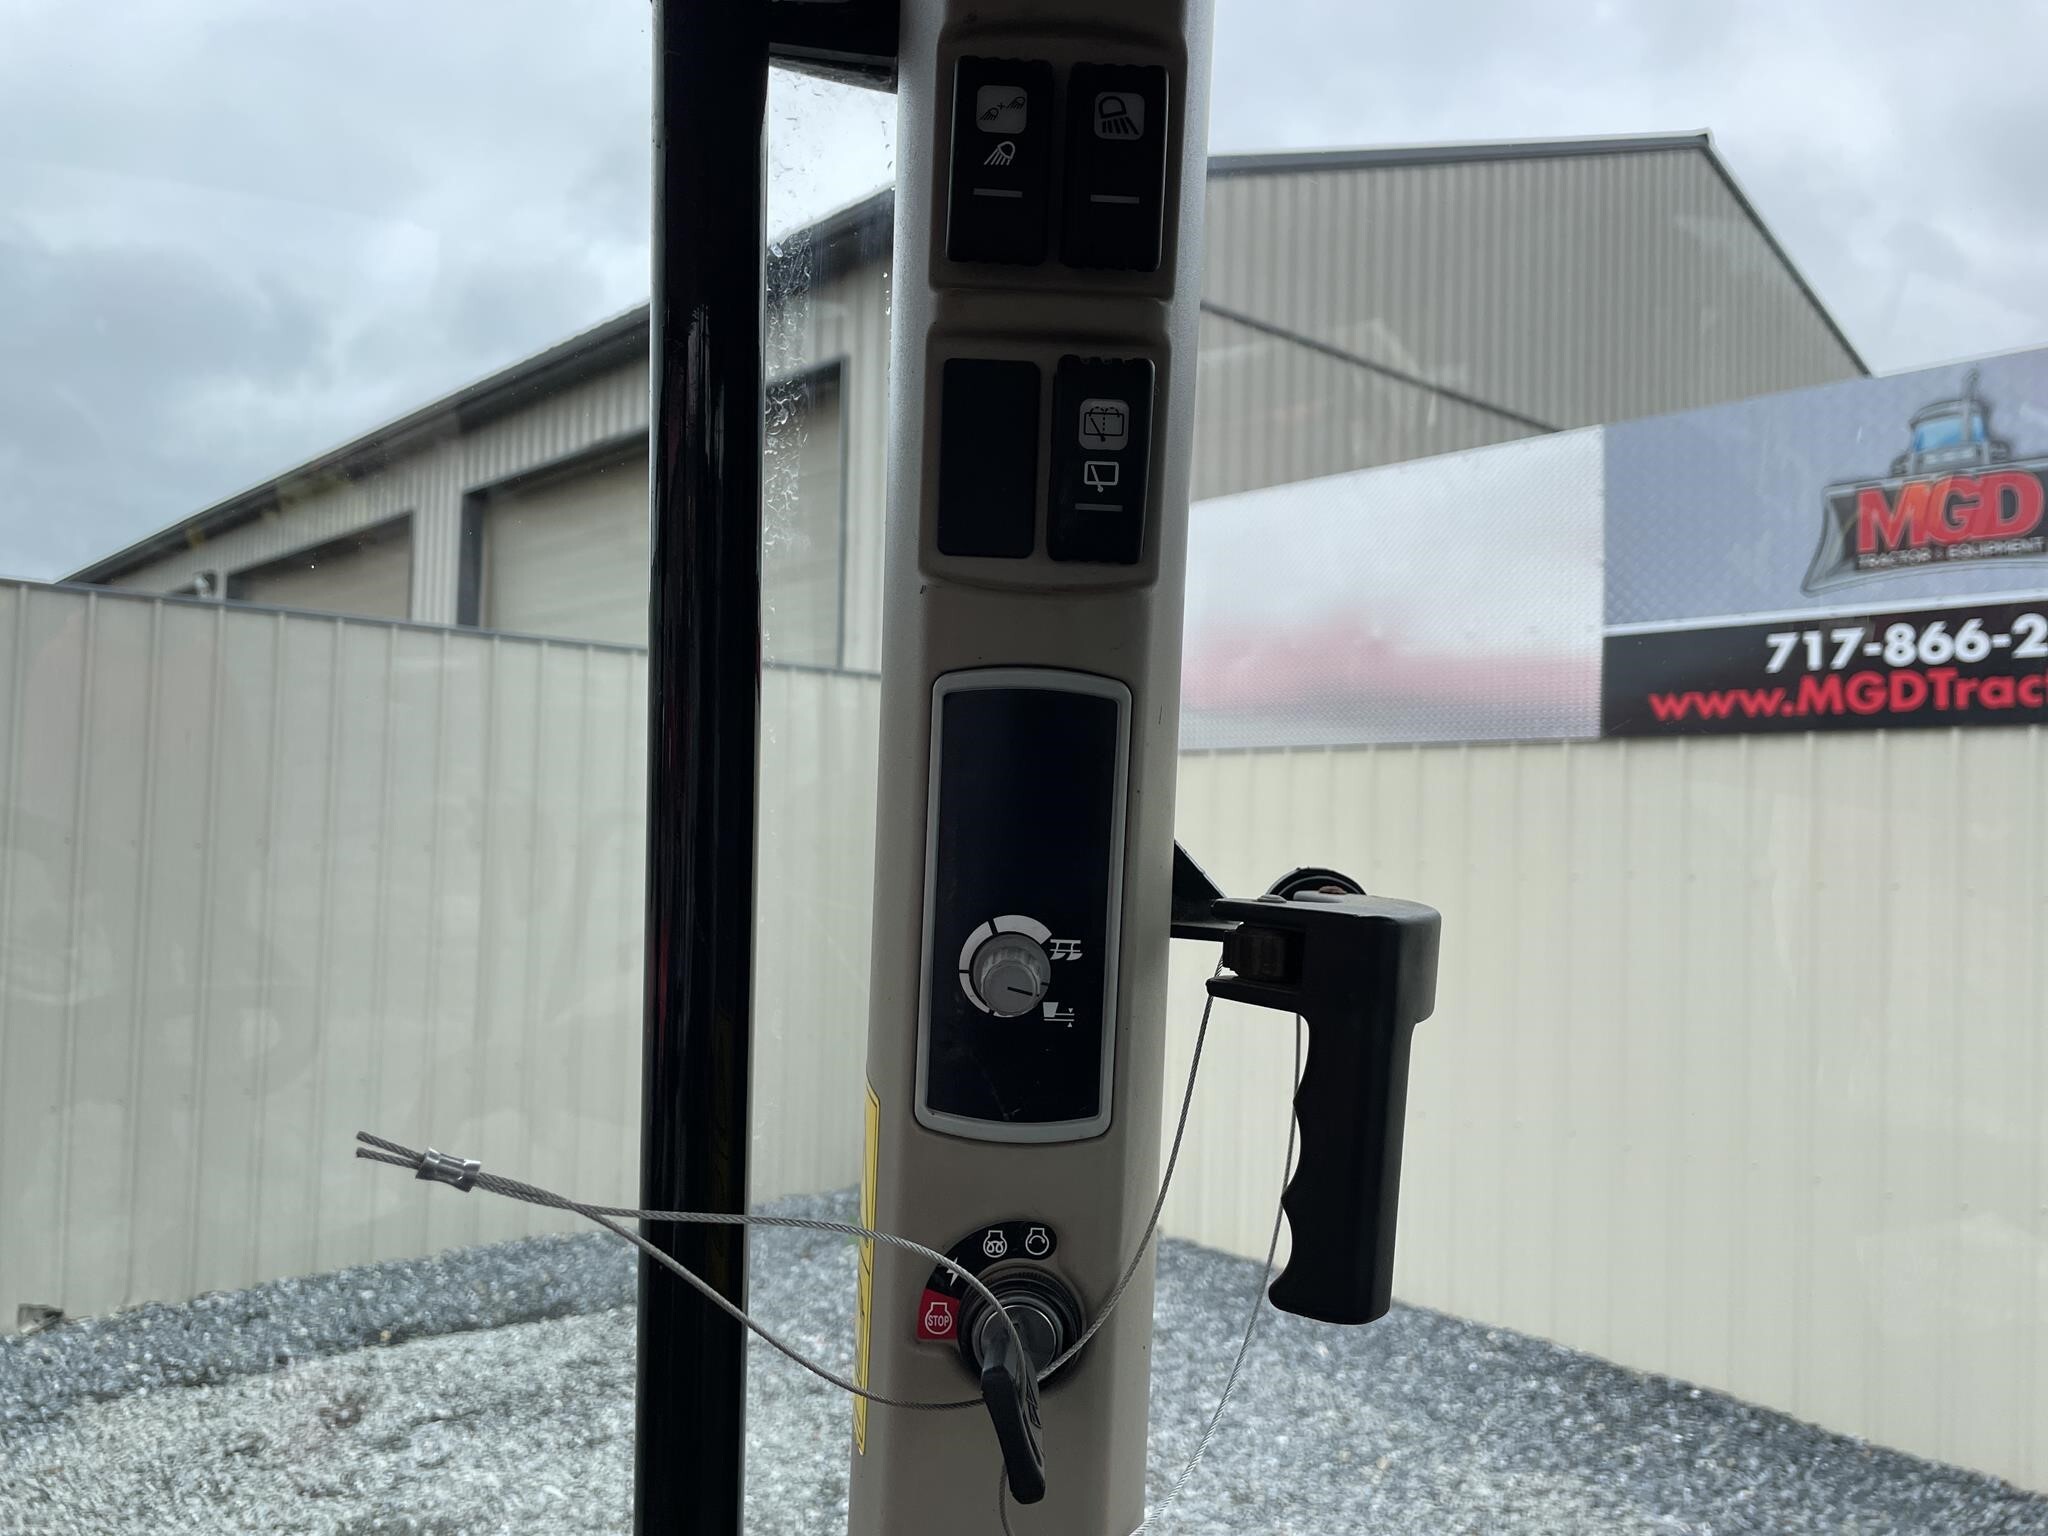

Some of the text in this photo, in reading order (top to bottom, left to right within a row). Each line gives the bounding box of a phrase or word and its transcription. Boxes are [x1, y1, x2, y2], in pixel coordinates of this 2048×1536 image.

[1856, 469, 2044, 554] MGD
[1765, 613, 2048, 673] 717-866-2
[1648, 667, 2048, 720] www.MGDTrac
[927, 1315, 950, 1327] STOP
